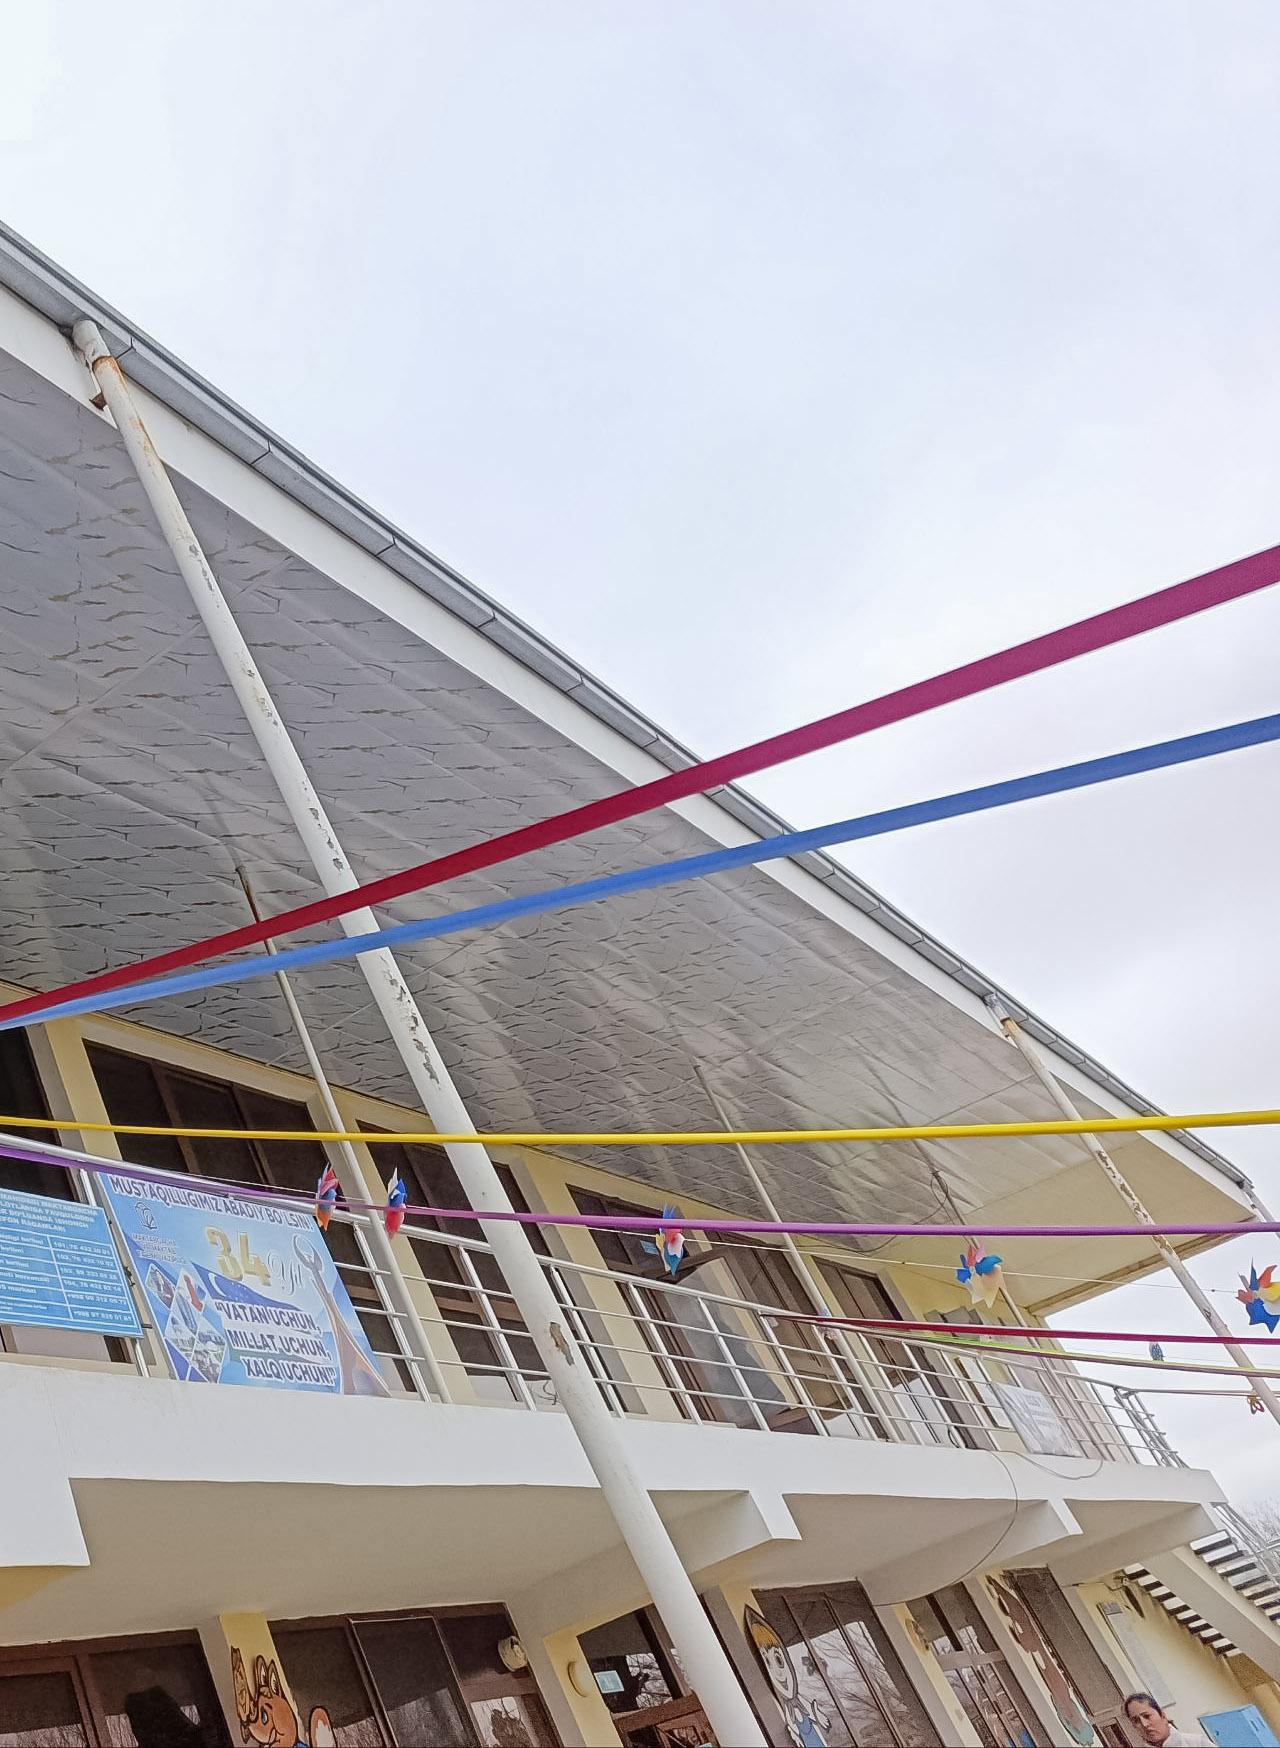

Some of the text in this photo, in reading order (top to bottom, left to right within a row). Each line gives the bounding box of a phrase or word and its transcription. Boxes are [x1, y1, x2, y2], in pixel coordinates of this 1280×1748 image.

[110, 1176, 222, 1211] MUSTAQILLIGIMIZ
[225, 1200, 265, 1221] ABADIY
[205, 1227, 271, 1286] 34
[270, 1308, 320, 1331] UCHUN,
[227, 1329, 332, 1361] MILLAT UCHUN,
[242, 1358, 283, 1380] XALQ
